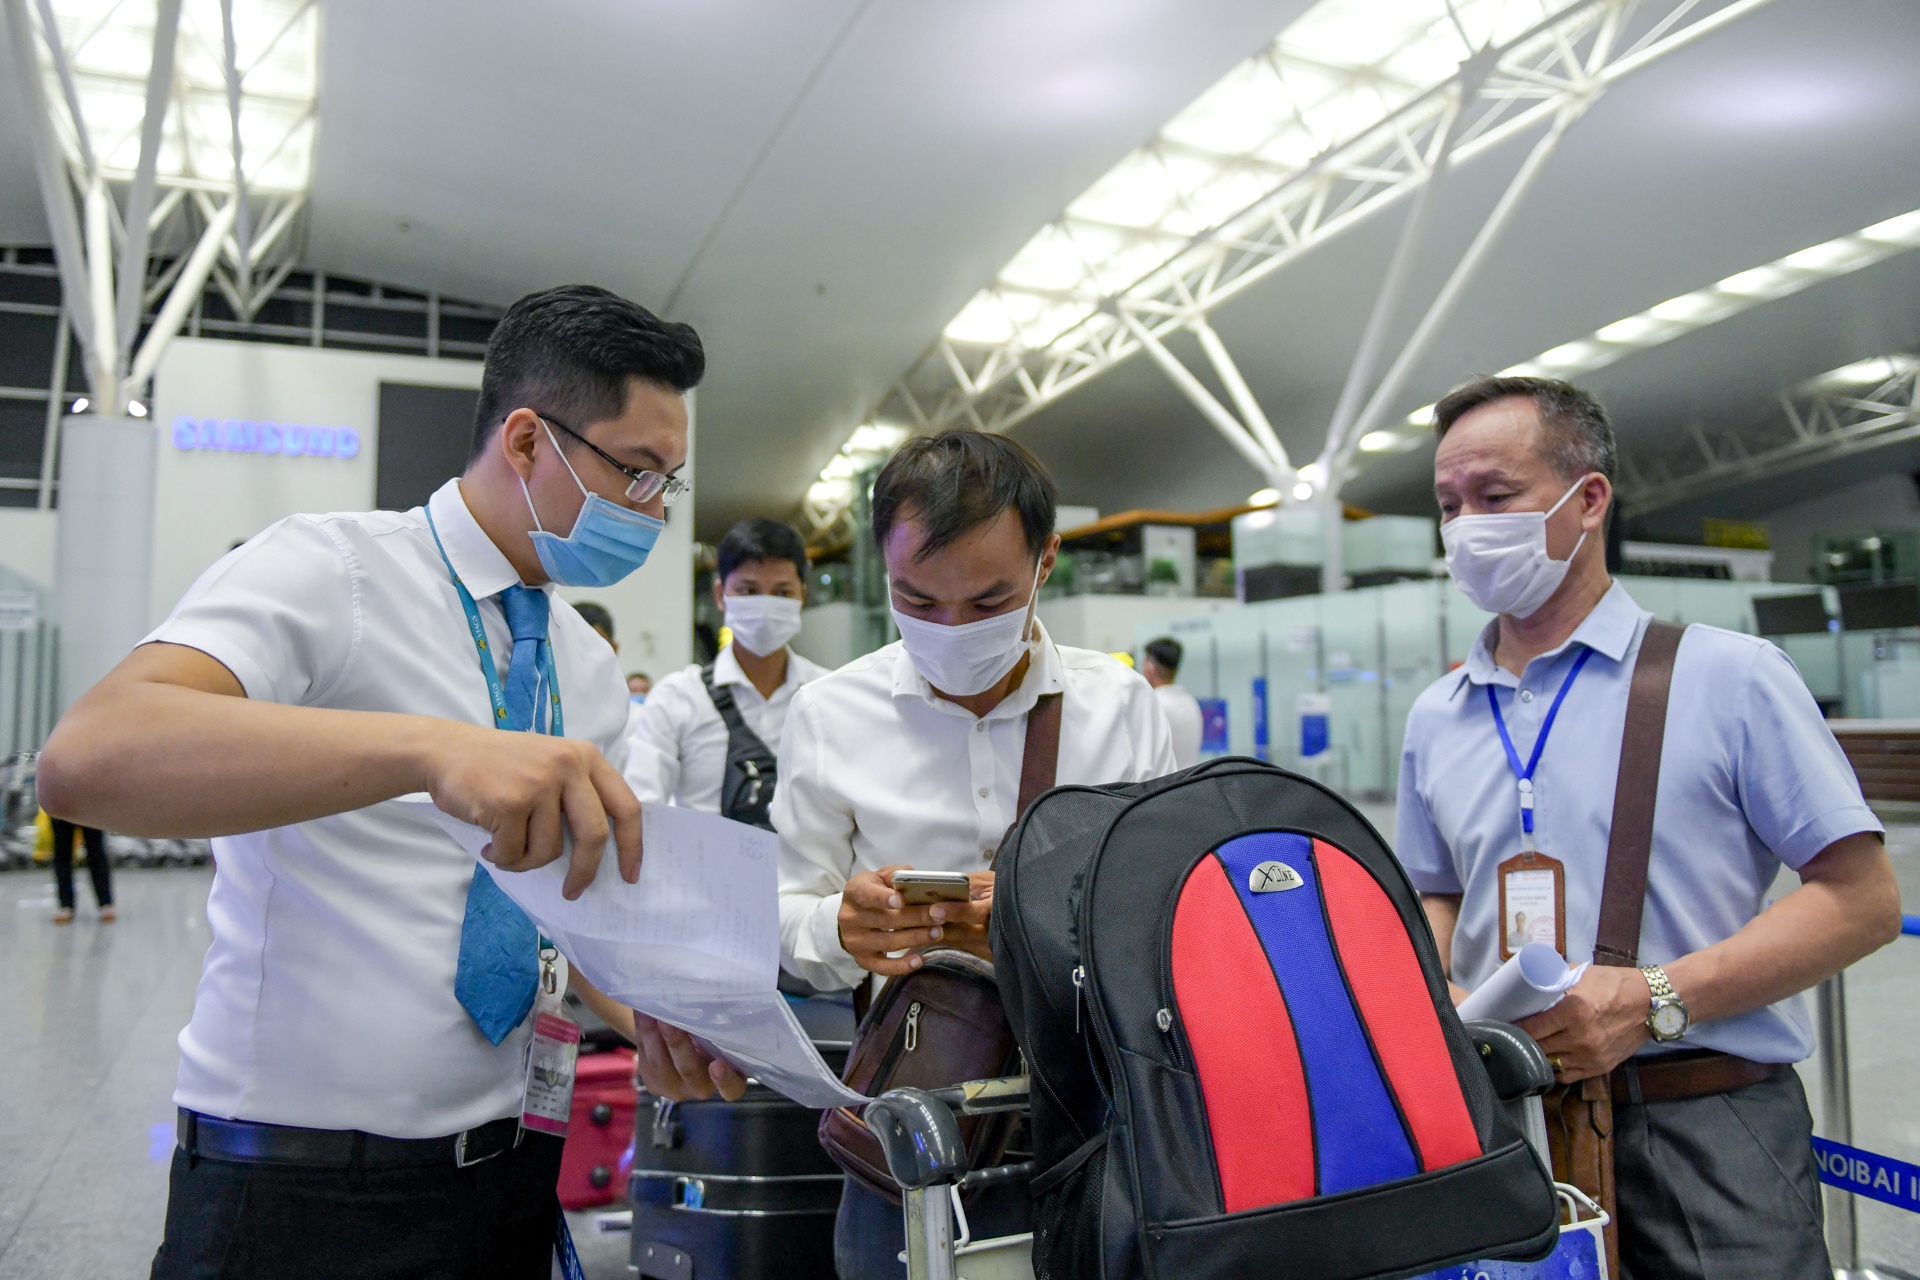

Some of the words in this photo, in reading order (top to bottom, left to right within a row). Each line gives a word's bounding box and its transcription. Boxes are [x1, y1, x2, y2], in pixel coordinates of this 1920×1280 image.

[171, 415, 359, 459] SAMSUNG
[472, 615, 483, 638] VIAGS
[491, 682, 504, 707] VIAGS
